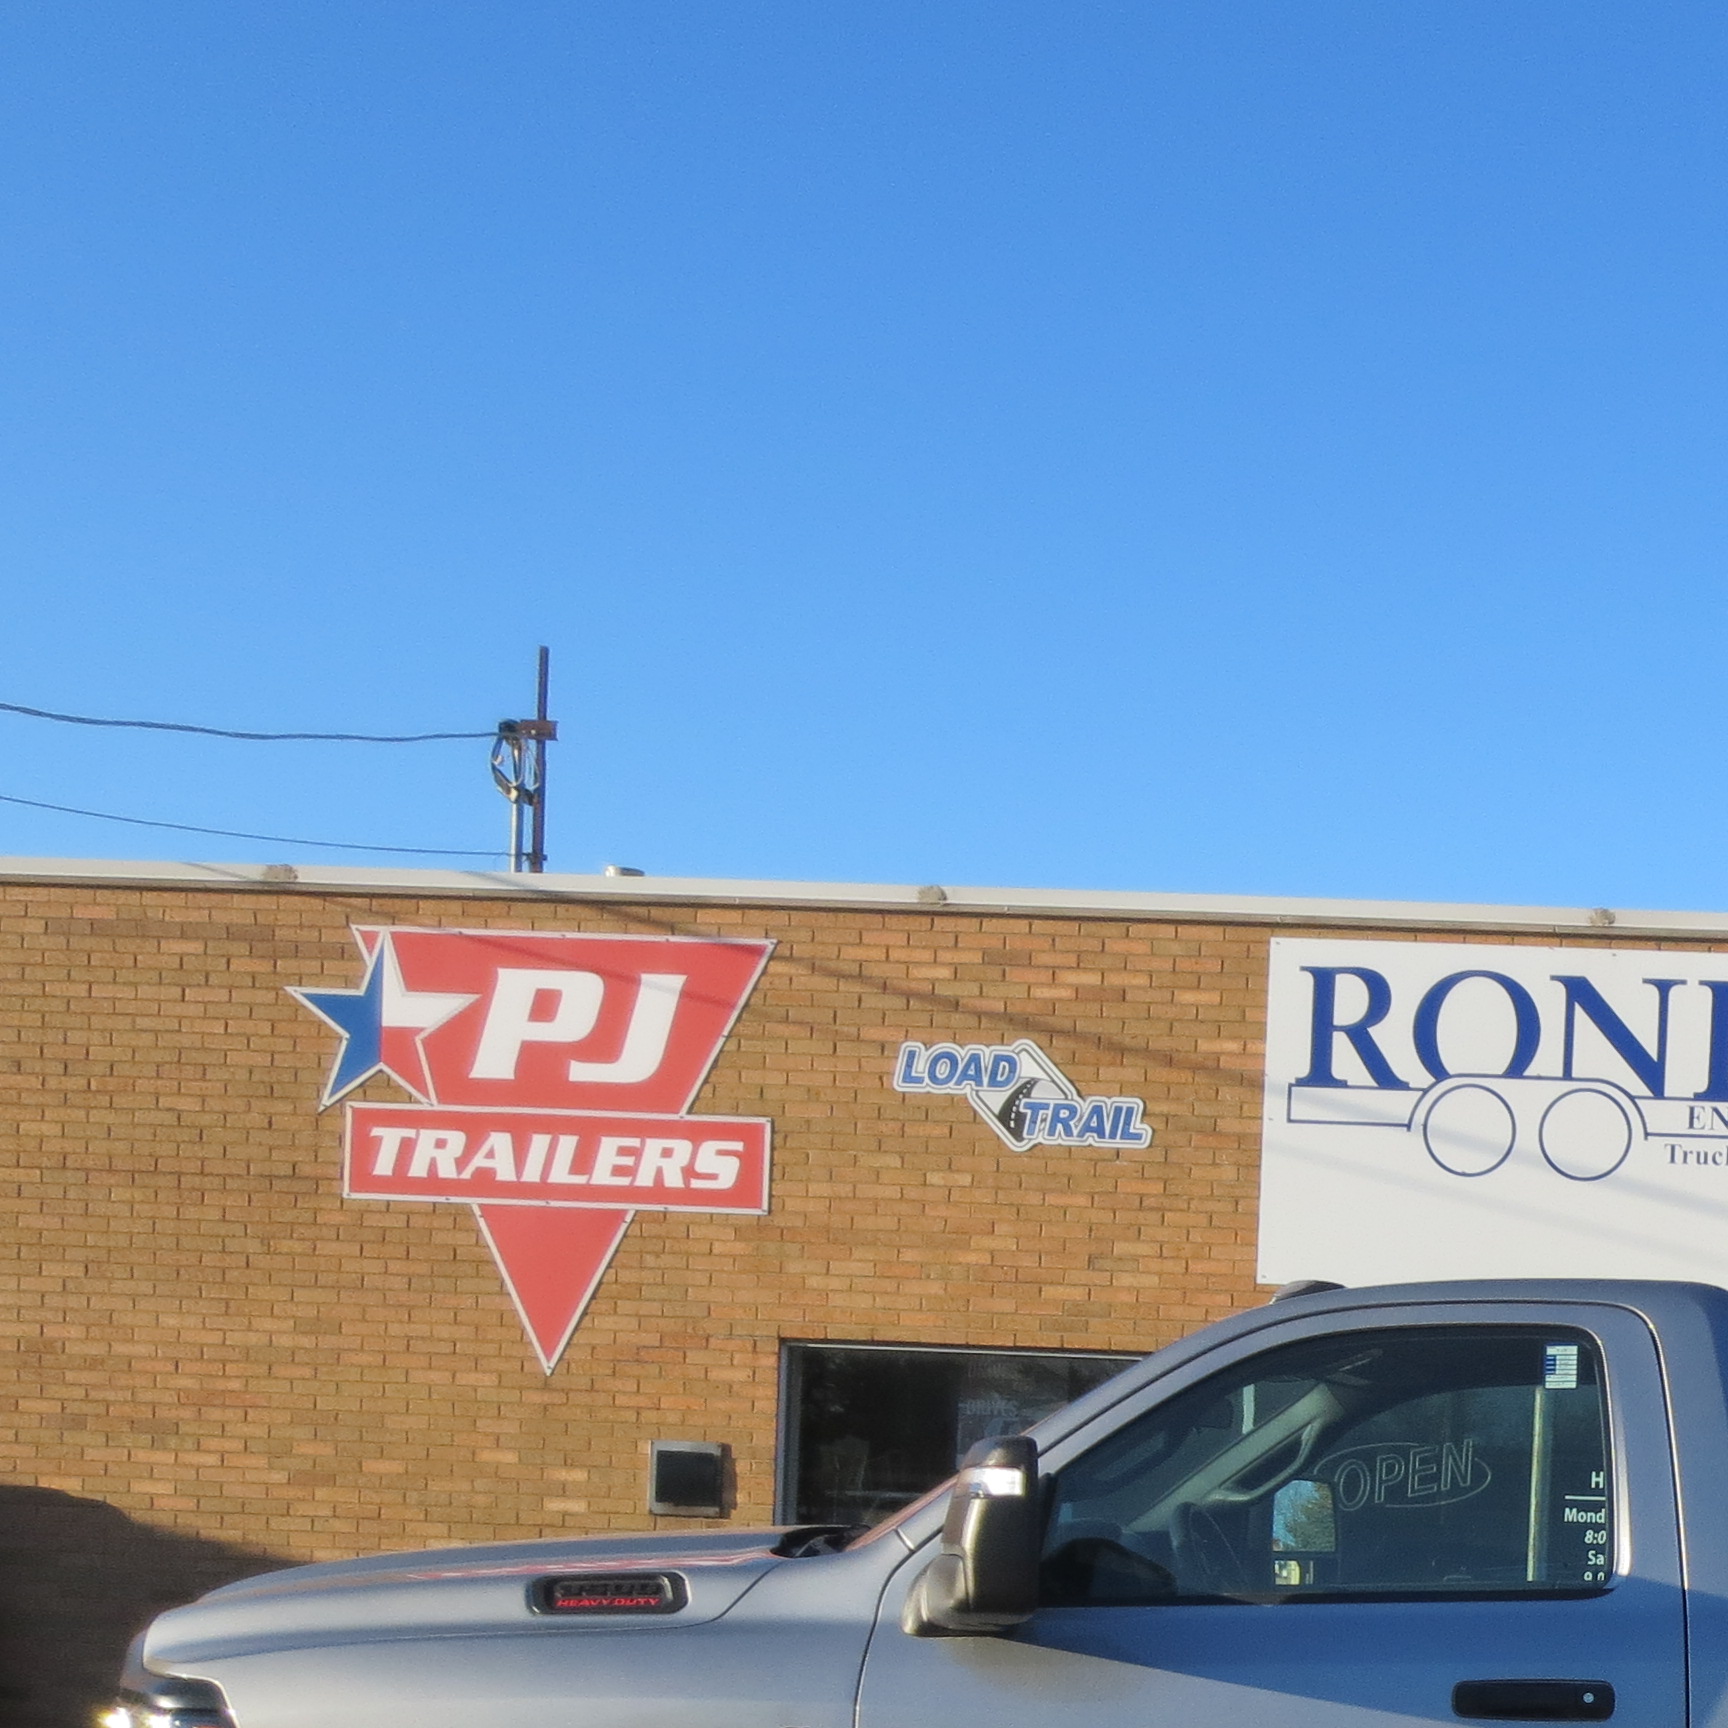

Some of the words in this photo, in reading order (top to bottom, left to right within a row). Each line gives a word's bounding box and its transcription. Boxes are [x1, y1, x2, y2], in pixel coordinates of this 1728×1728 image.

[468, 967, 687, 1085] PJ
[901, 1045, 1018, 1091] LOAD
[1020, 1099, 1145, 1144] TRAIL
[369, 1126, 745, 1190] TRAILERS
[1334, 1438, 1472, 1511] OPEN
[556, 1598, 611, 1607] HEAVY
[614, 1598, 660, 1606] DUTY
